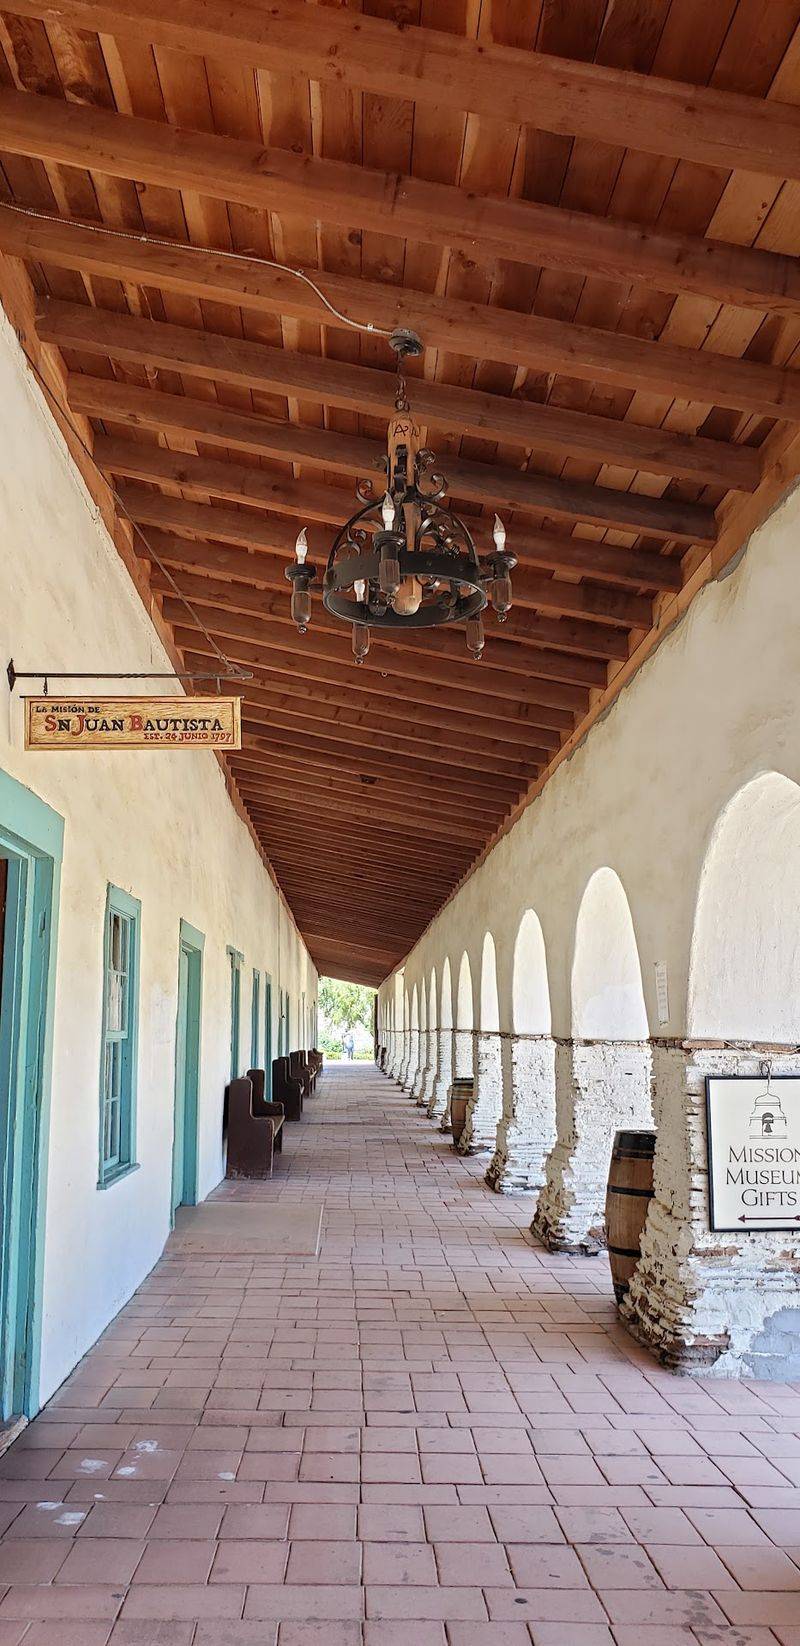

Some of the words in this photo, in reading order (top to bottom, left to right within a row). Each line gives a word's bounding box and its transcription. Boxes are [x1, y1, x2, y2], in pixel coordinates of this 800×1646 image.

[51, 704, 85, 713] MISIÓN
[71, 714, 124, 736] JUAN
[129, 714, 223, 731] BAUTISTA
[179, 733, 208, 741] JUNIO
[211, 733, 232, 742] 1797
[726, 1167, 800, 1185] MUSEU
[741, 1189, 797, 1207] GIFTS
